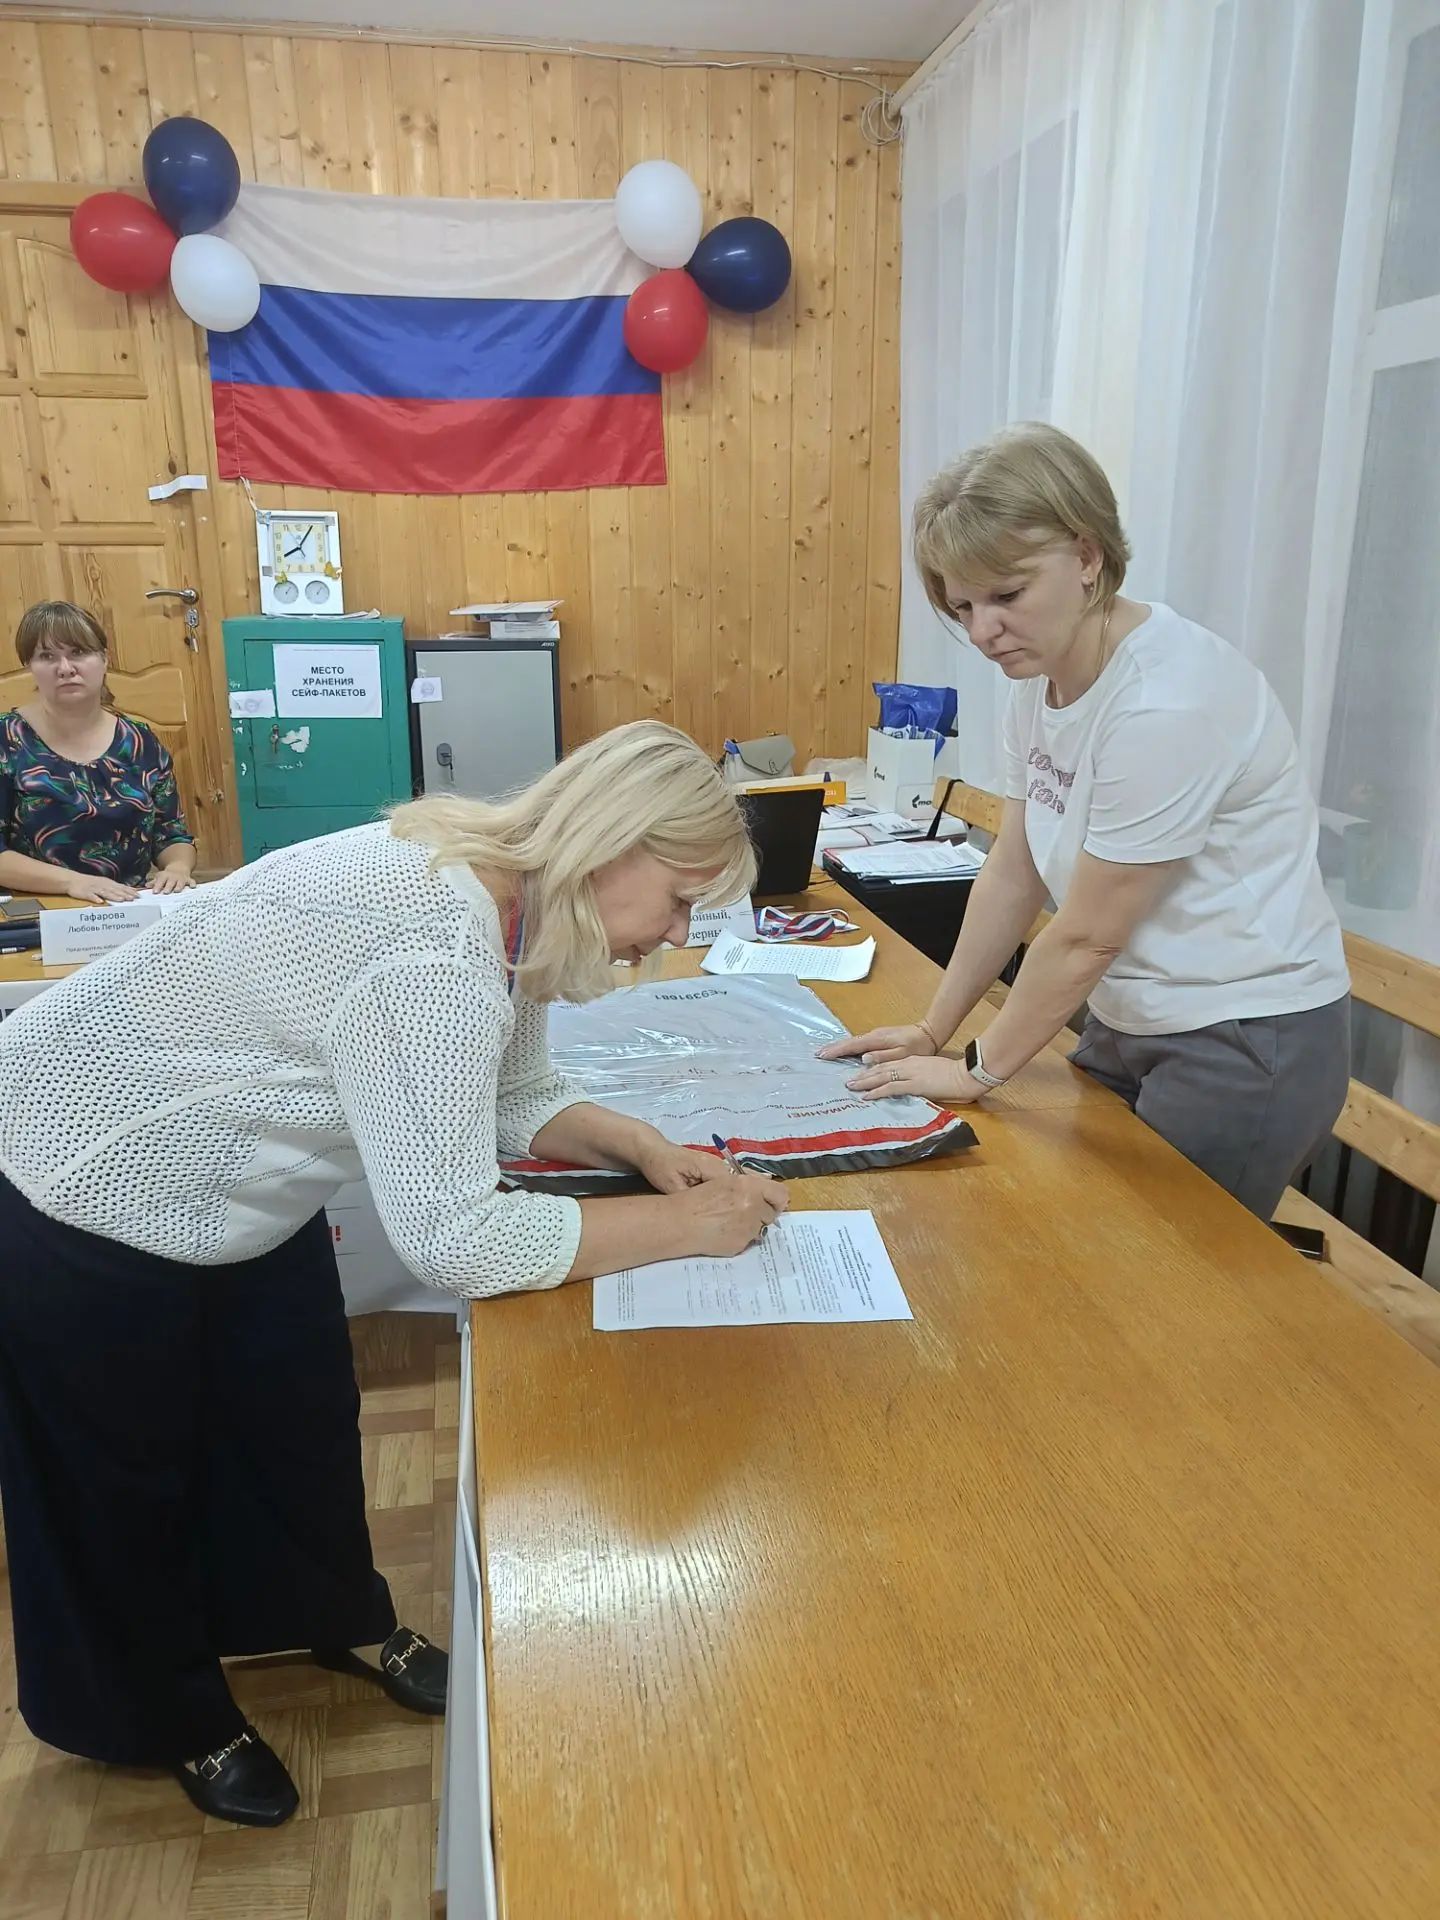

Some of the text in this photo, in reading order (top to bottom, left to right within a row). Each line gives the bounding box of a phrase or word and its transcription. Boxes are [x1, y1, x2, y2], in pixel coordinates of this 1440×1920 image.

[311, 666, 345, 675] МЕСТО
[302, 677, 354, 686] ХРАНЕНИЯ
[291, 687, 367, 697] СЕЙФ-ПАКЕТОВ
[79, 912, 126, 922] Гафарова
[691, 909, 732, 922] ойный,
[68, 922, 140, 933] Любовь Петровна
